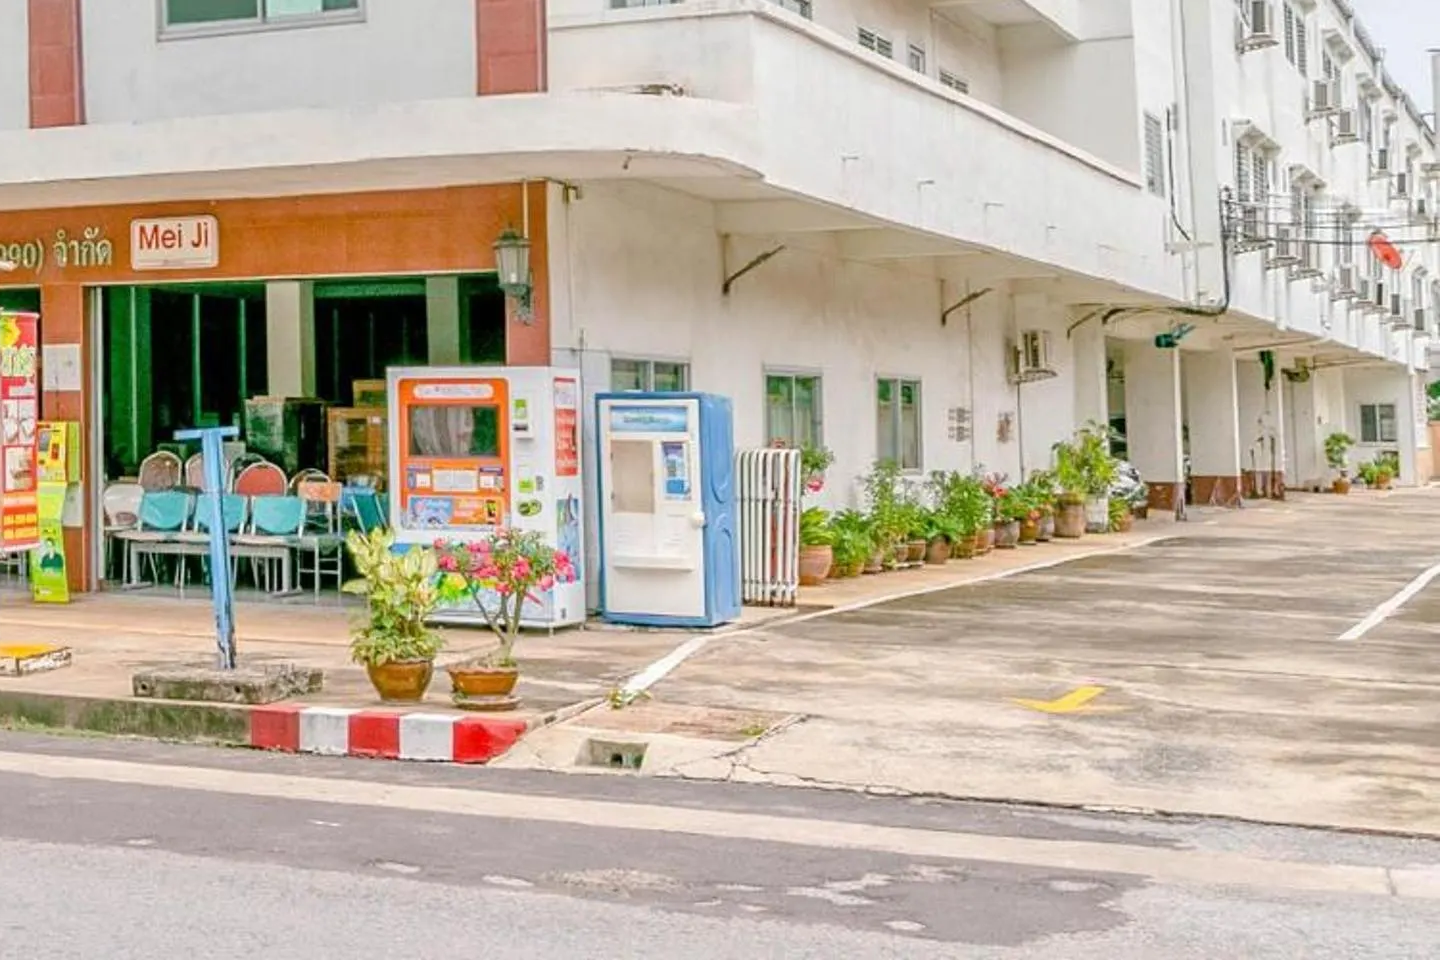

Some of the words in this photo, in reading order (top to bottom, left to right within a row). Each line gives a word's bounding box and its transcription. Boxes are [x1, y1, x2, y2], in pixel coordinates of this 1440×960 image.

[52, 227, 113, 268] จำกัด
[139, 223, 182, 250] Mei
[192, 222, 209, 249] Ji
